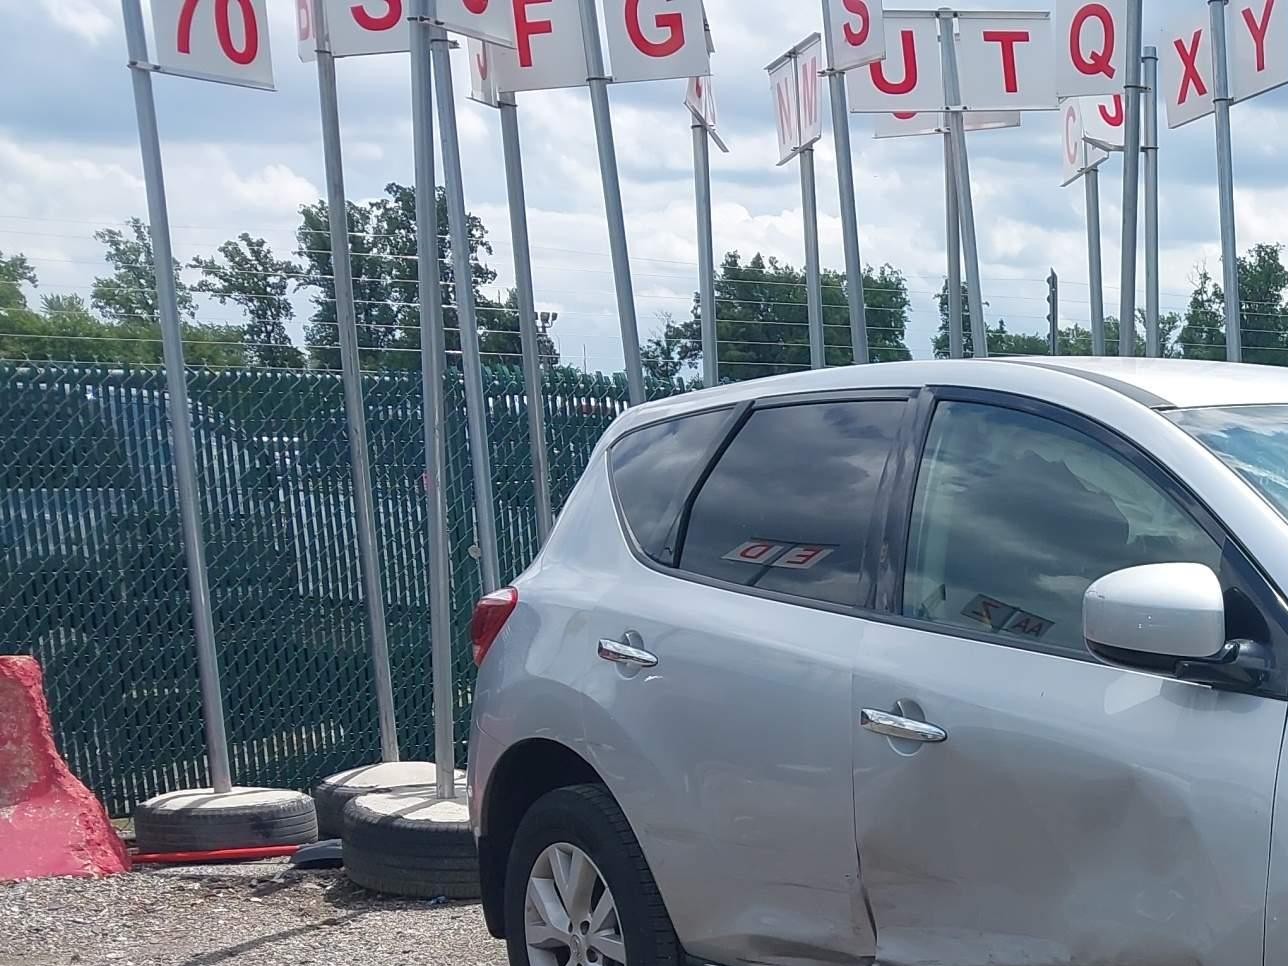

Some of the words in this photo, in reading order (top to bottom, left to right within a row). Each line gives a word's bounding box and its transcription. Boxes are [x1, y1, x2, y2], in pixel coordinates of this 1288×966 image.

[512, 0, 552, 68] F
[625, 0, 685, 58] G
[843, 0, 870, 46] S
[1069, 3, 1116, 80] Q
[1241, 0, 1276, 72] Y
[869, 30, 918, 95] U
[982, 31, 1030, 93] T
[1173, 28, 1208, 105] X
